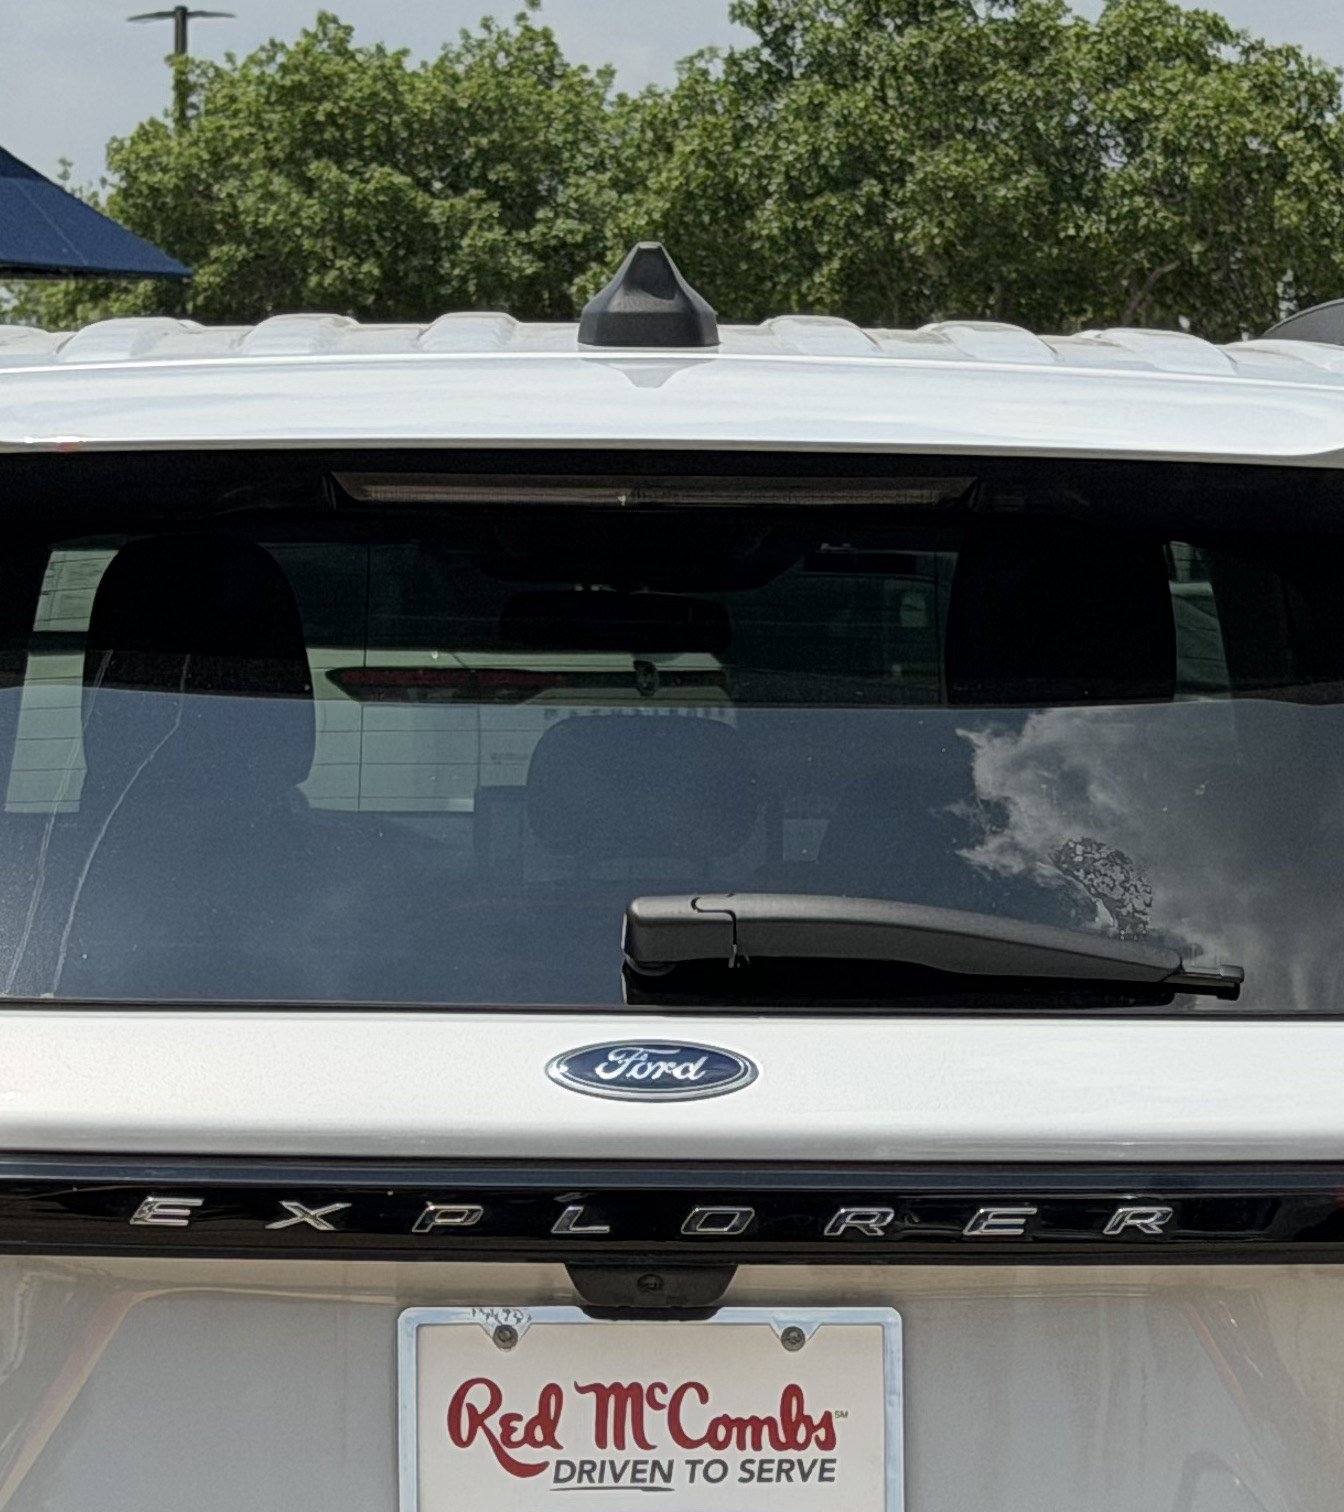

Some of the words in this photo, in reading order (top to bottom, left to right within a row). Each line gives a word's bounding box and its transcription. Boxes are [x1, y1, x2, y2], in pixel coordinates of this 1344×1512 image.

[594, 1046, 707, 1081] Ford
[129, 1197, 1174, 1237] EXPLORER
[447, 1377, 563, 1479] Red
[573, 1379, 837, 1452] McCombs
[552, 1459, 675, 1485] DRIVEN
[684, 1459, 731, 1484] TO
[737, 1459, 838, 1484] SERVE
